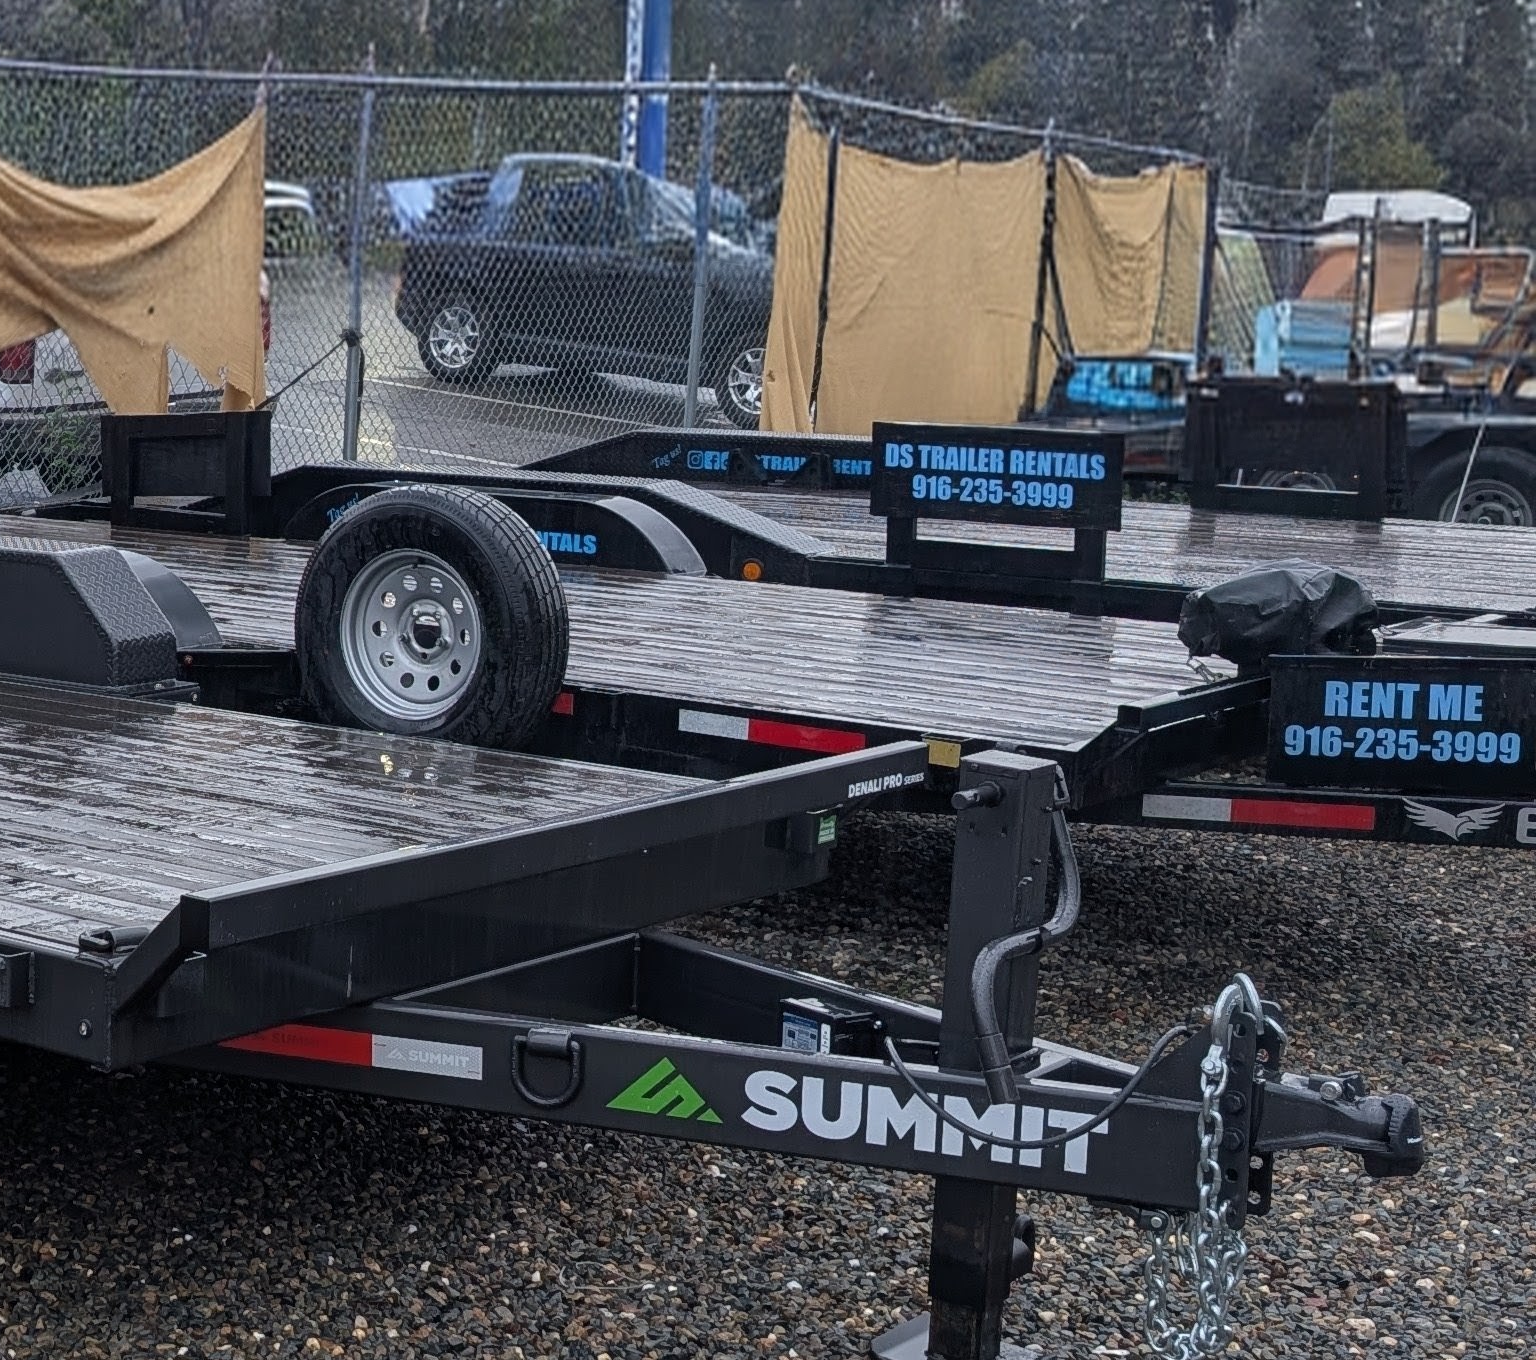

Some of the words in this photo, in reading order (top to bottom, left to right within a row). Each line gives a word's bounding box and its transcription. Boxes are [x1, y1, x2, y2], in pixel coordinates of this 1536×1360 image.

[884, 443, 913, 468] DS
[918, 444, 1004, 474] TRAILER
[1009, 450, 1106, 480] RENTALS
[912, 474, 1074, 509] 916-235-3999
[536, 530, 597, 555] NTALS
[1324, 680, 1421, 720] RENT
[1428, 684, 1484, 722] ME
[1284, 724, 1521, 764] 916-235-3999
[847, 777, 882, 799] DENALI
[883, 772, 903, 790] PRO
[904, 772, 924, 786] SERIES
[408, 1049, 470, 1067] SUMMIT
[740, 1069, 1110, 1175] SUMMIT
